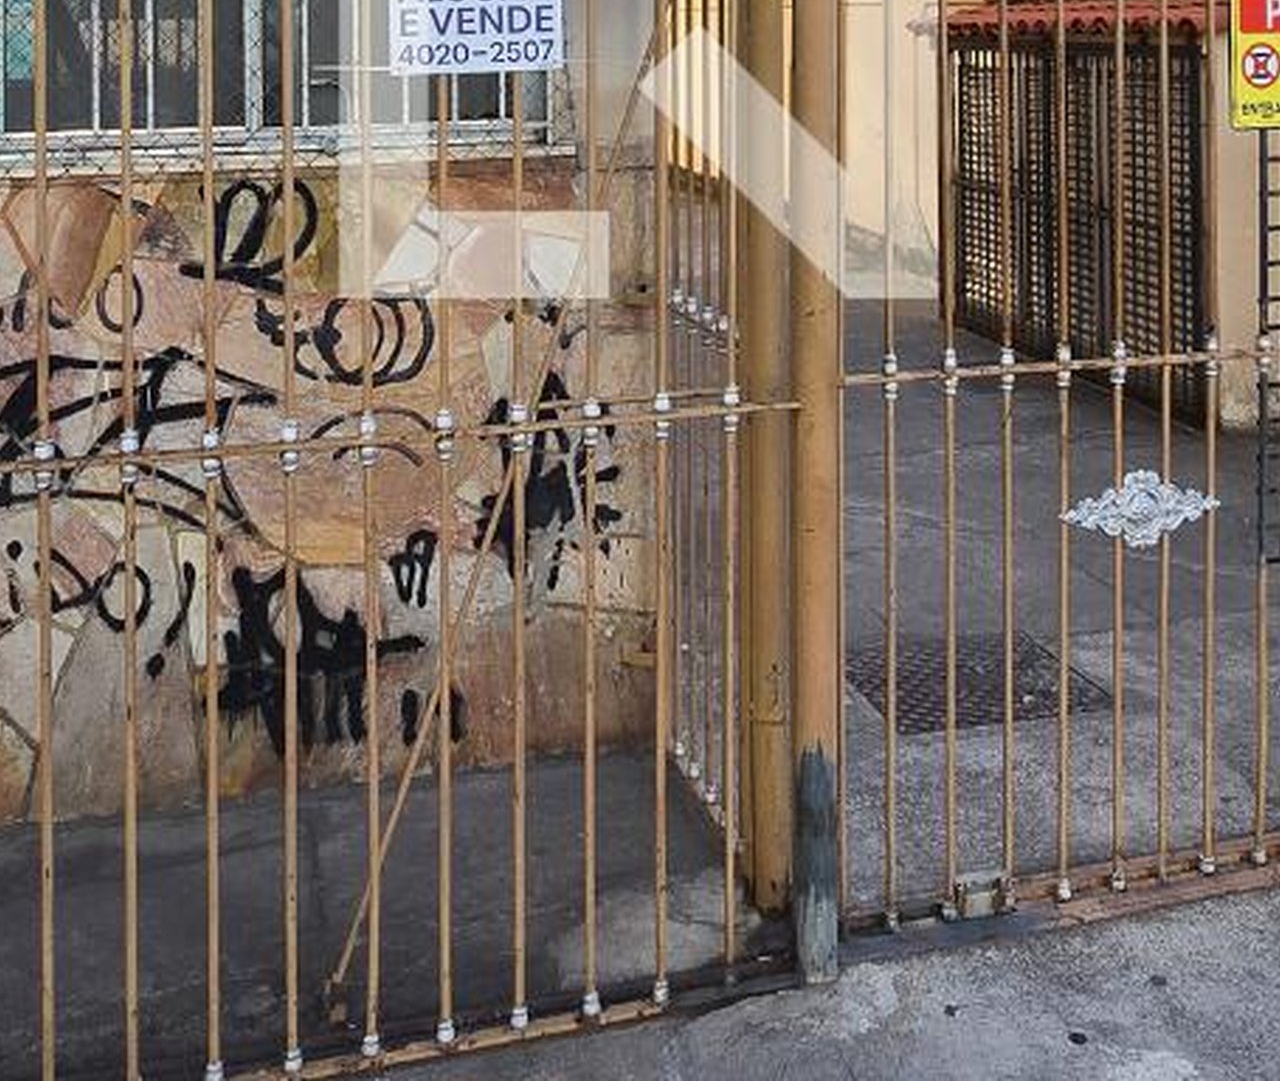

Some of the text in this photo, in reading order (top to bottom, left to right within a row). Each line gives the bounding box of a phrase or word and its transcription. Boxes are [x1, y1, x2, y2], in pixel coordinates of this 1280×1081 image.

[400, 5, 554, 37] E VENDE
[398, 40, 554, 66] 4020-2507
